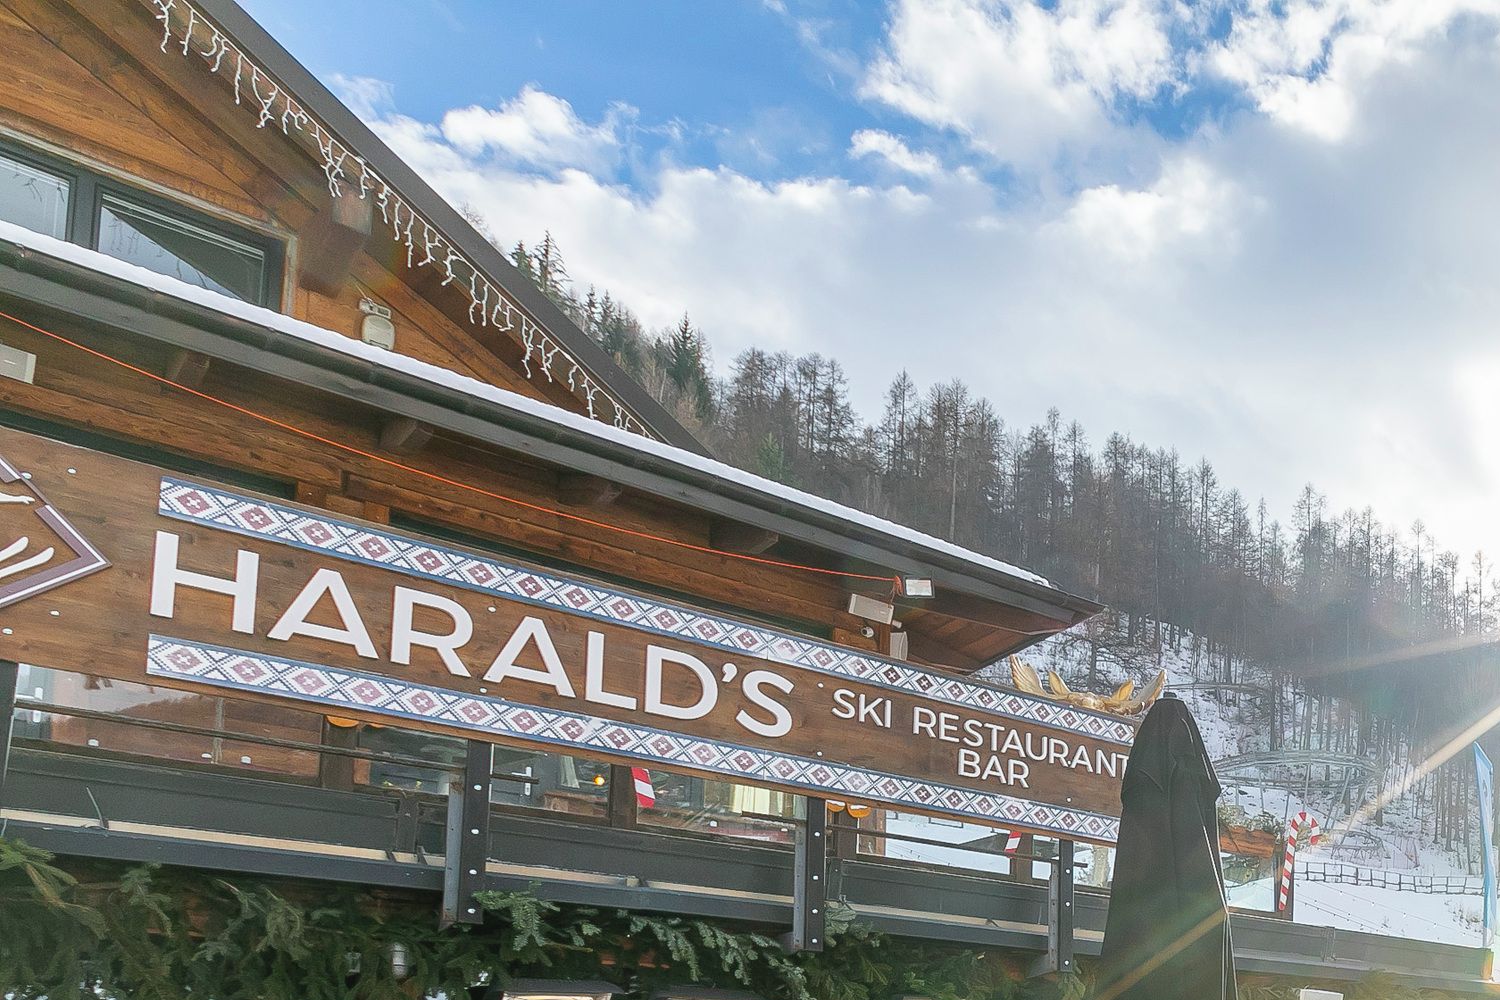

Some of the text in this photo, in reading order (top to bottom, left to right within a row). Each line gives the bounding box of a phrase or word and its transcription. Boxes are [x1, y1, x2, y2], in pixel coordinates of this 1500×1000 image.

[149, 530, 795, 738] HARALD'S
[831, 688, 1130, 779] SKI RESTAURANT
[957, 748, 1030, 788] BAR
